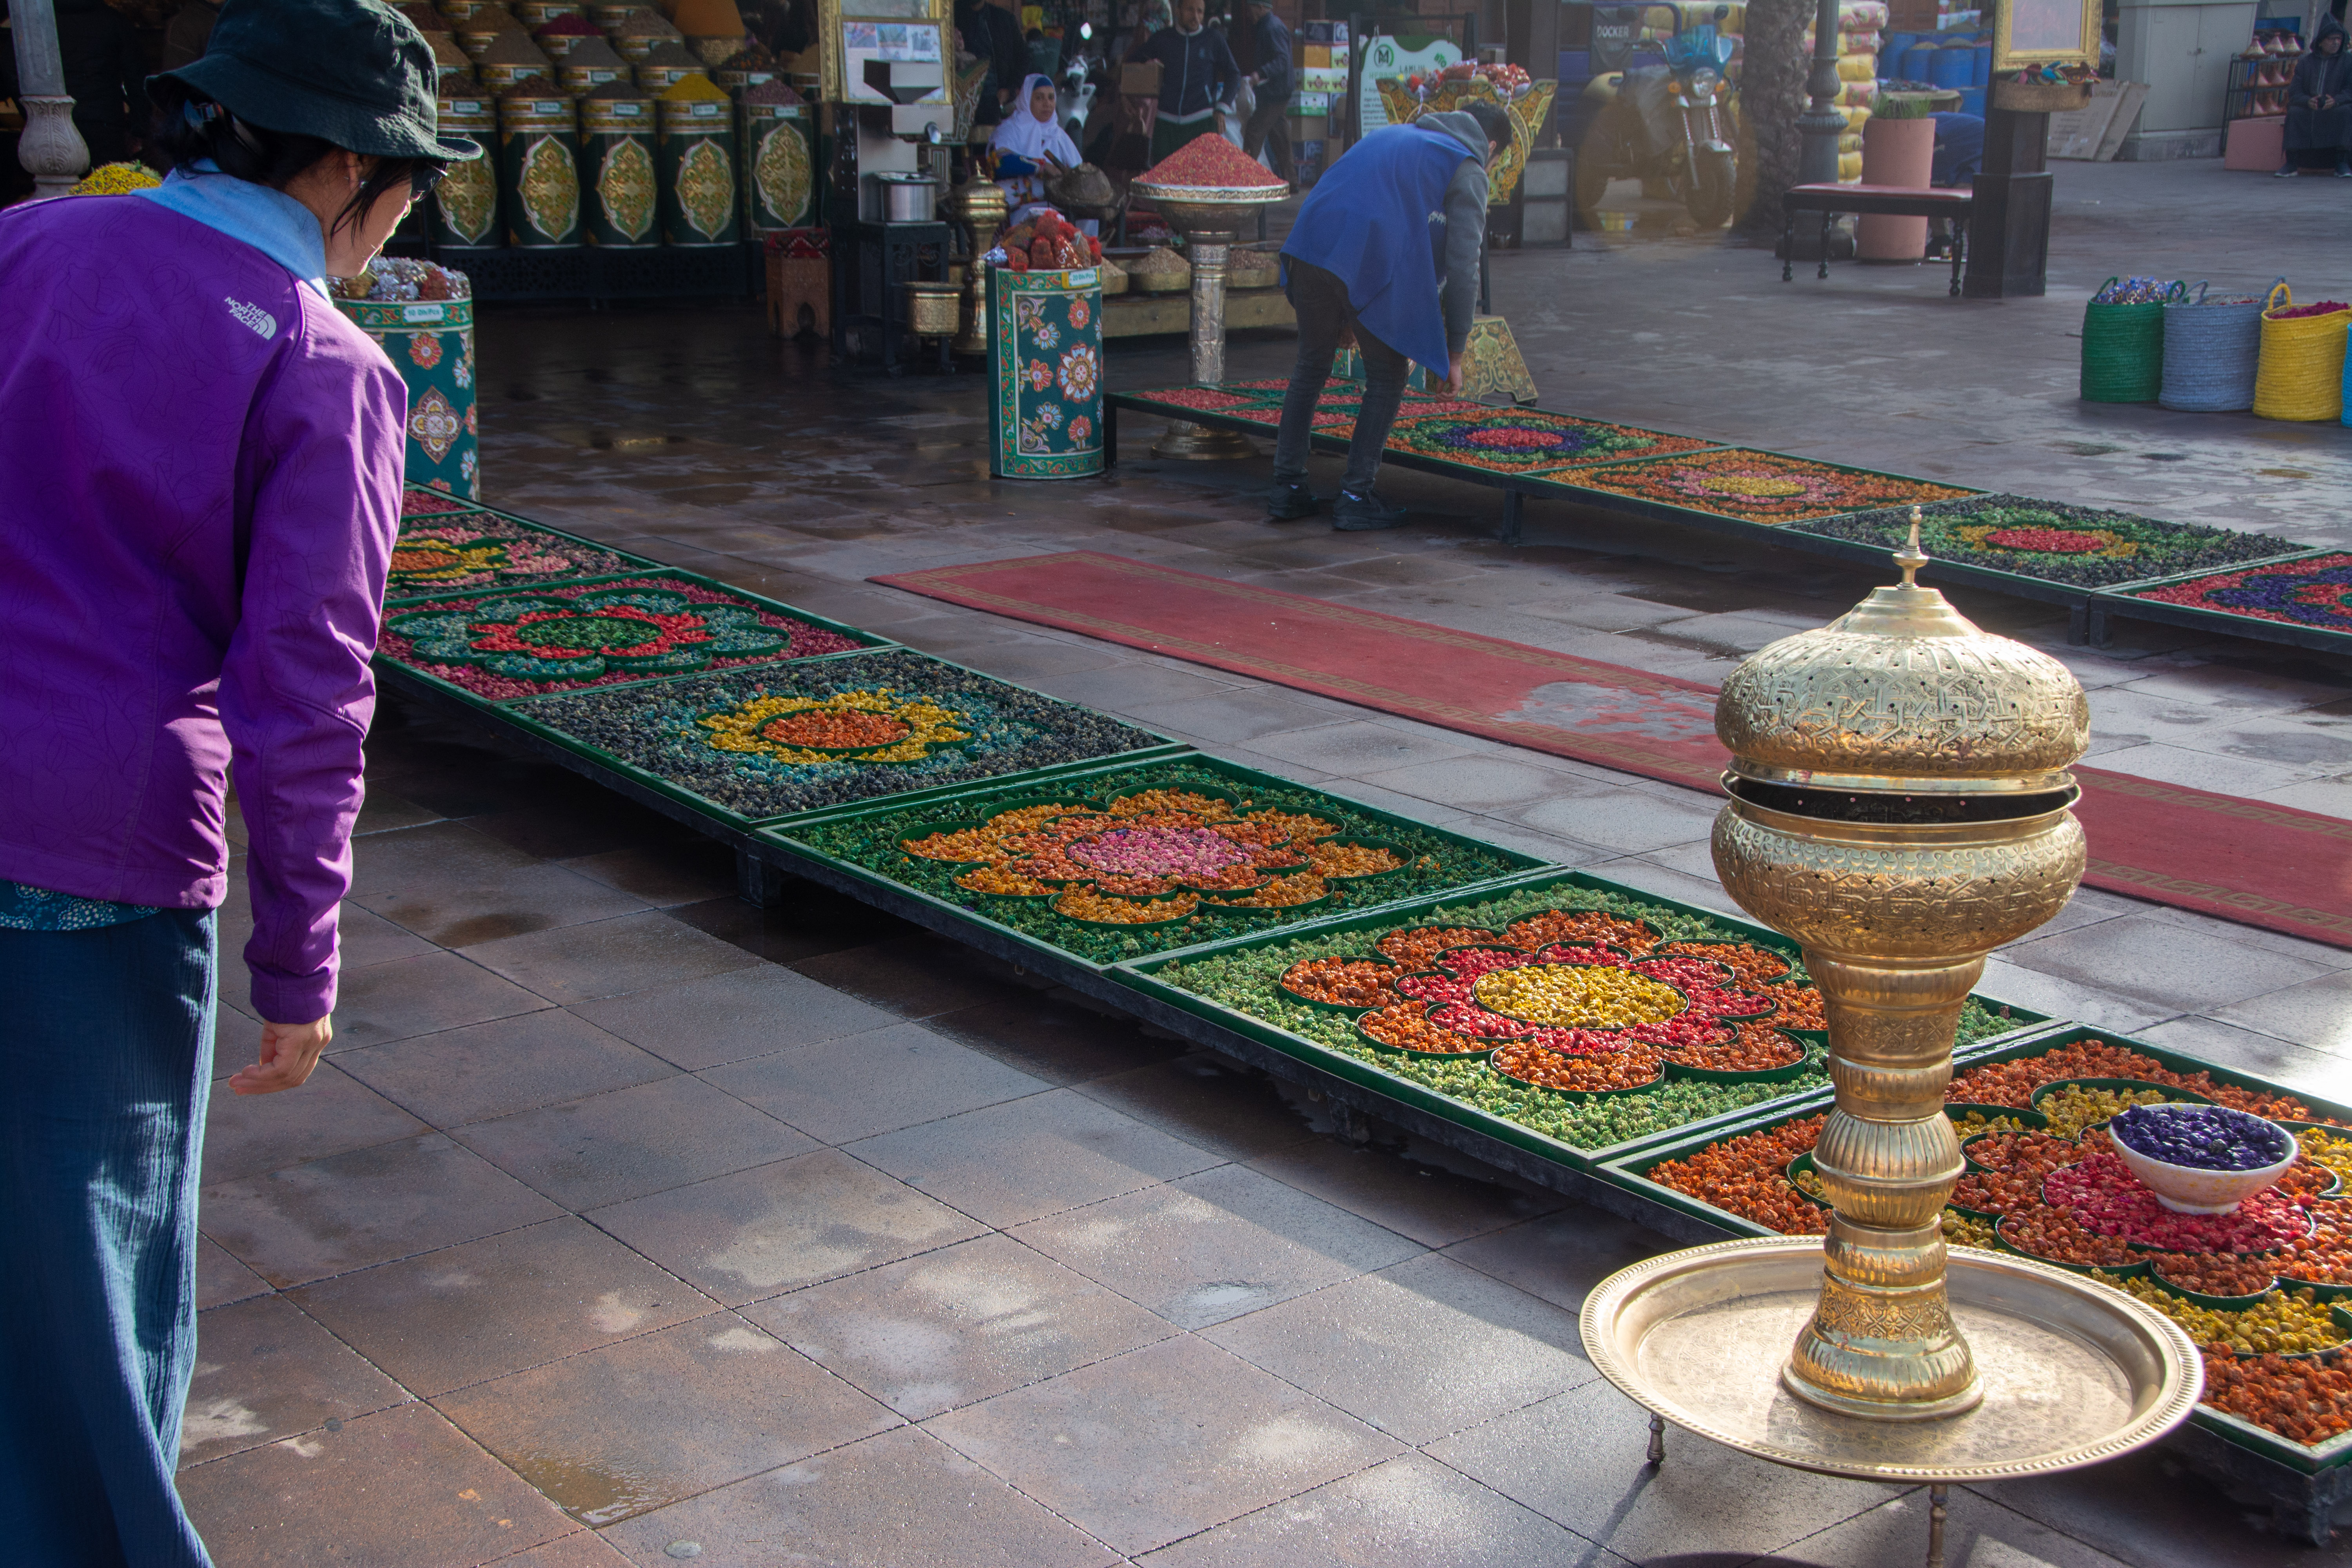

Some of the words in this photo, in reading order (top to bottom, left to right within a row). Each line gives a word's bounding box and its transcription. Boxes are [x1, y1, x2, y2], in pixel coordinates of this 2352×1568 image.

[1597, 25, 1629, 38] DOCKER
[224, 296, 261, 323] NORTH
[229, 308, 256, 328] FACE
[247, 301, 267, 318] THE
